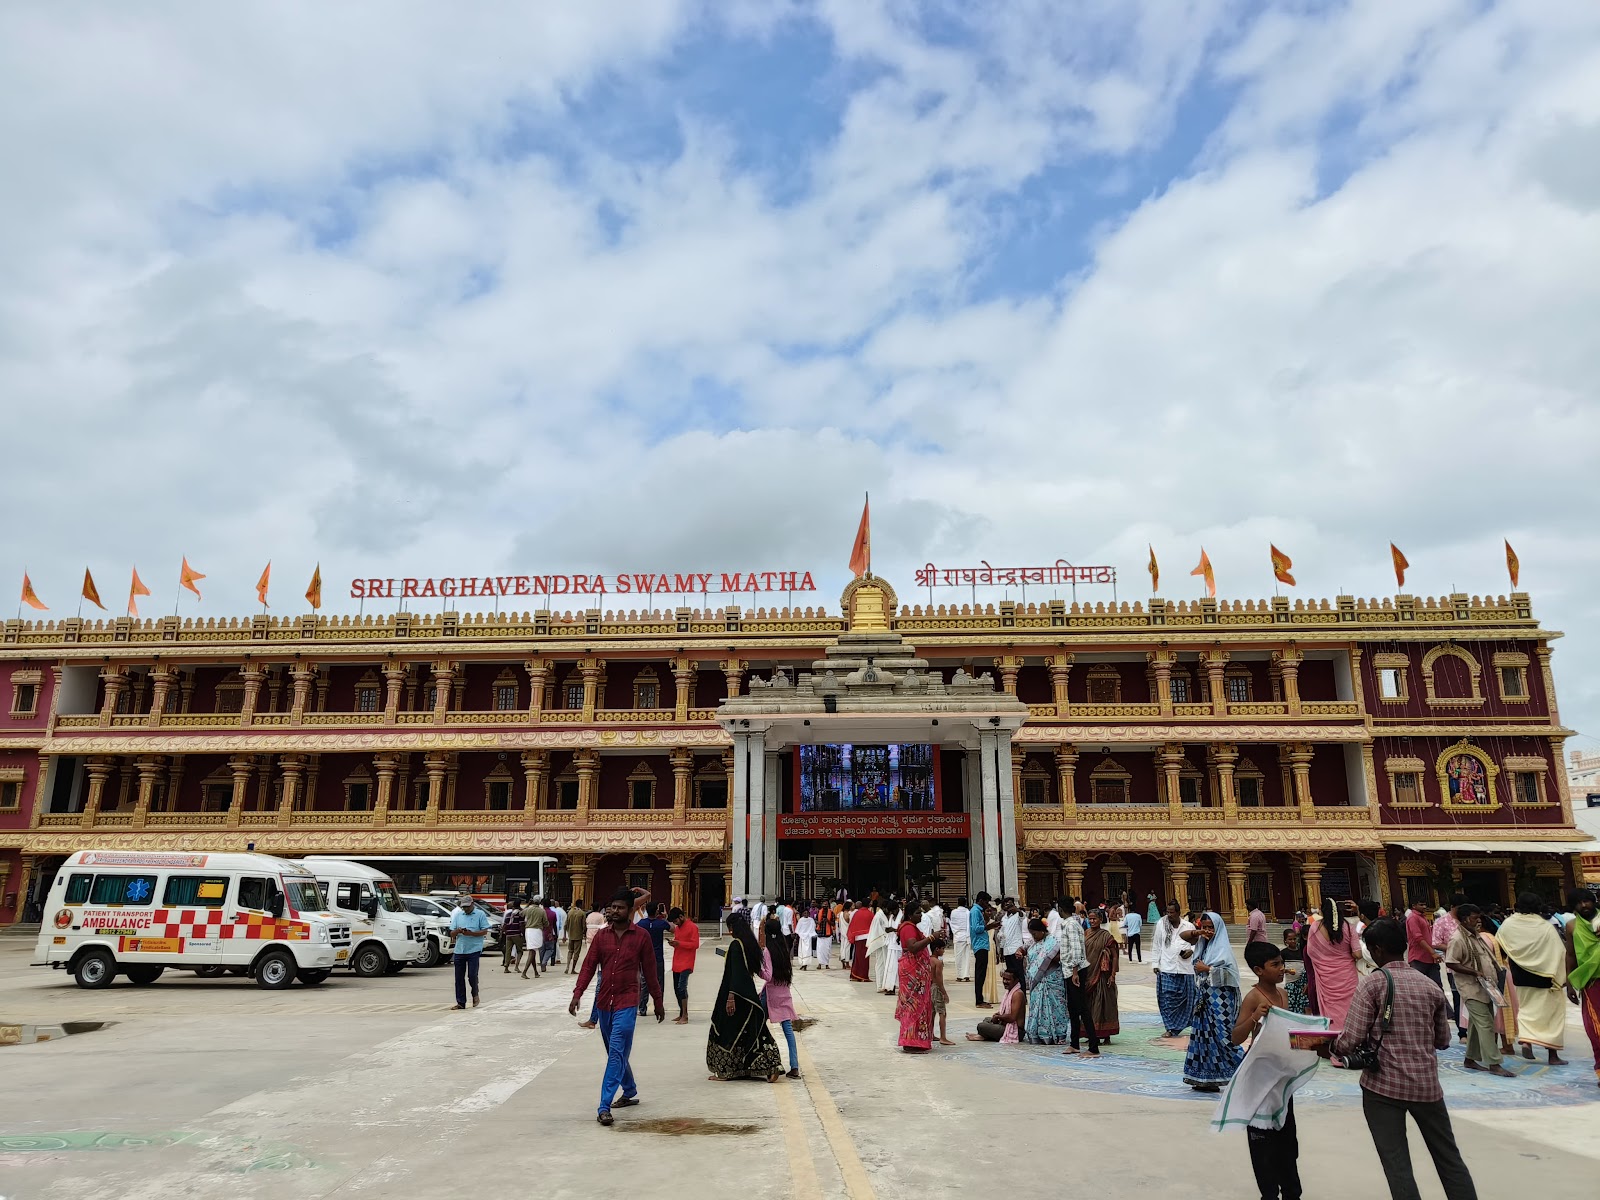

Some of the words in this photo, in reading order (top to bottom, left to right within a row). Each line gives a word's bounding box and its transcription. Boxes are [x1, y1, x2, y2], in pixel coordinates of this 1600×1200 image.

[350, 578, 393, 598] SRI
[402, 574, 608, 598] RAGHAVENDRA
[616, 573, 712, 594] SWAMY
[721, 571, 817, 592] MATHA
[915, 563, 938, 586] श्री
[82, 918, 151, 929] AMBULANCE
